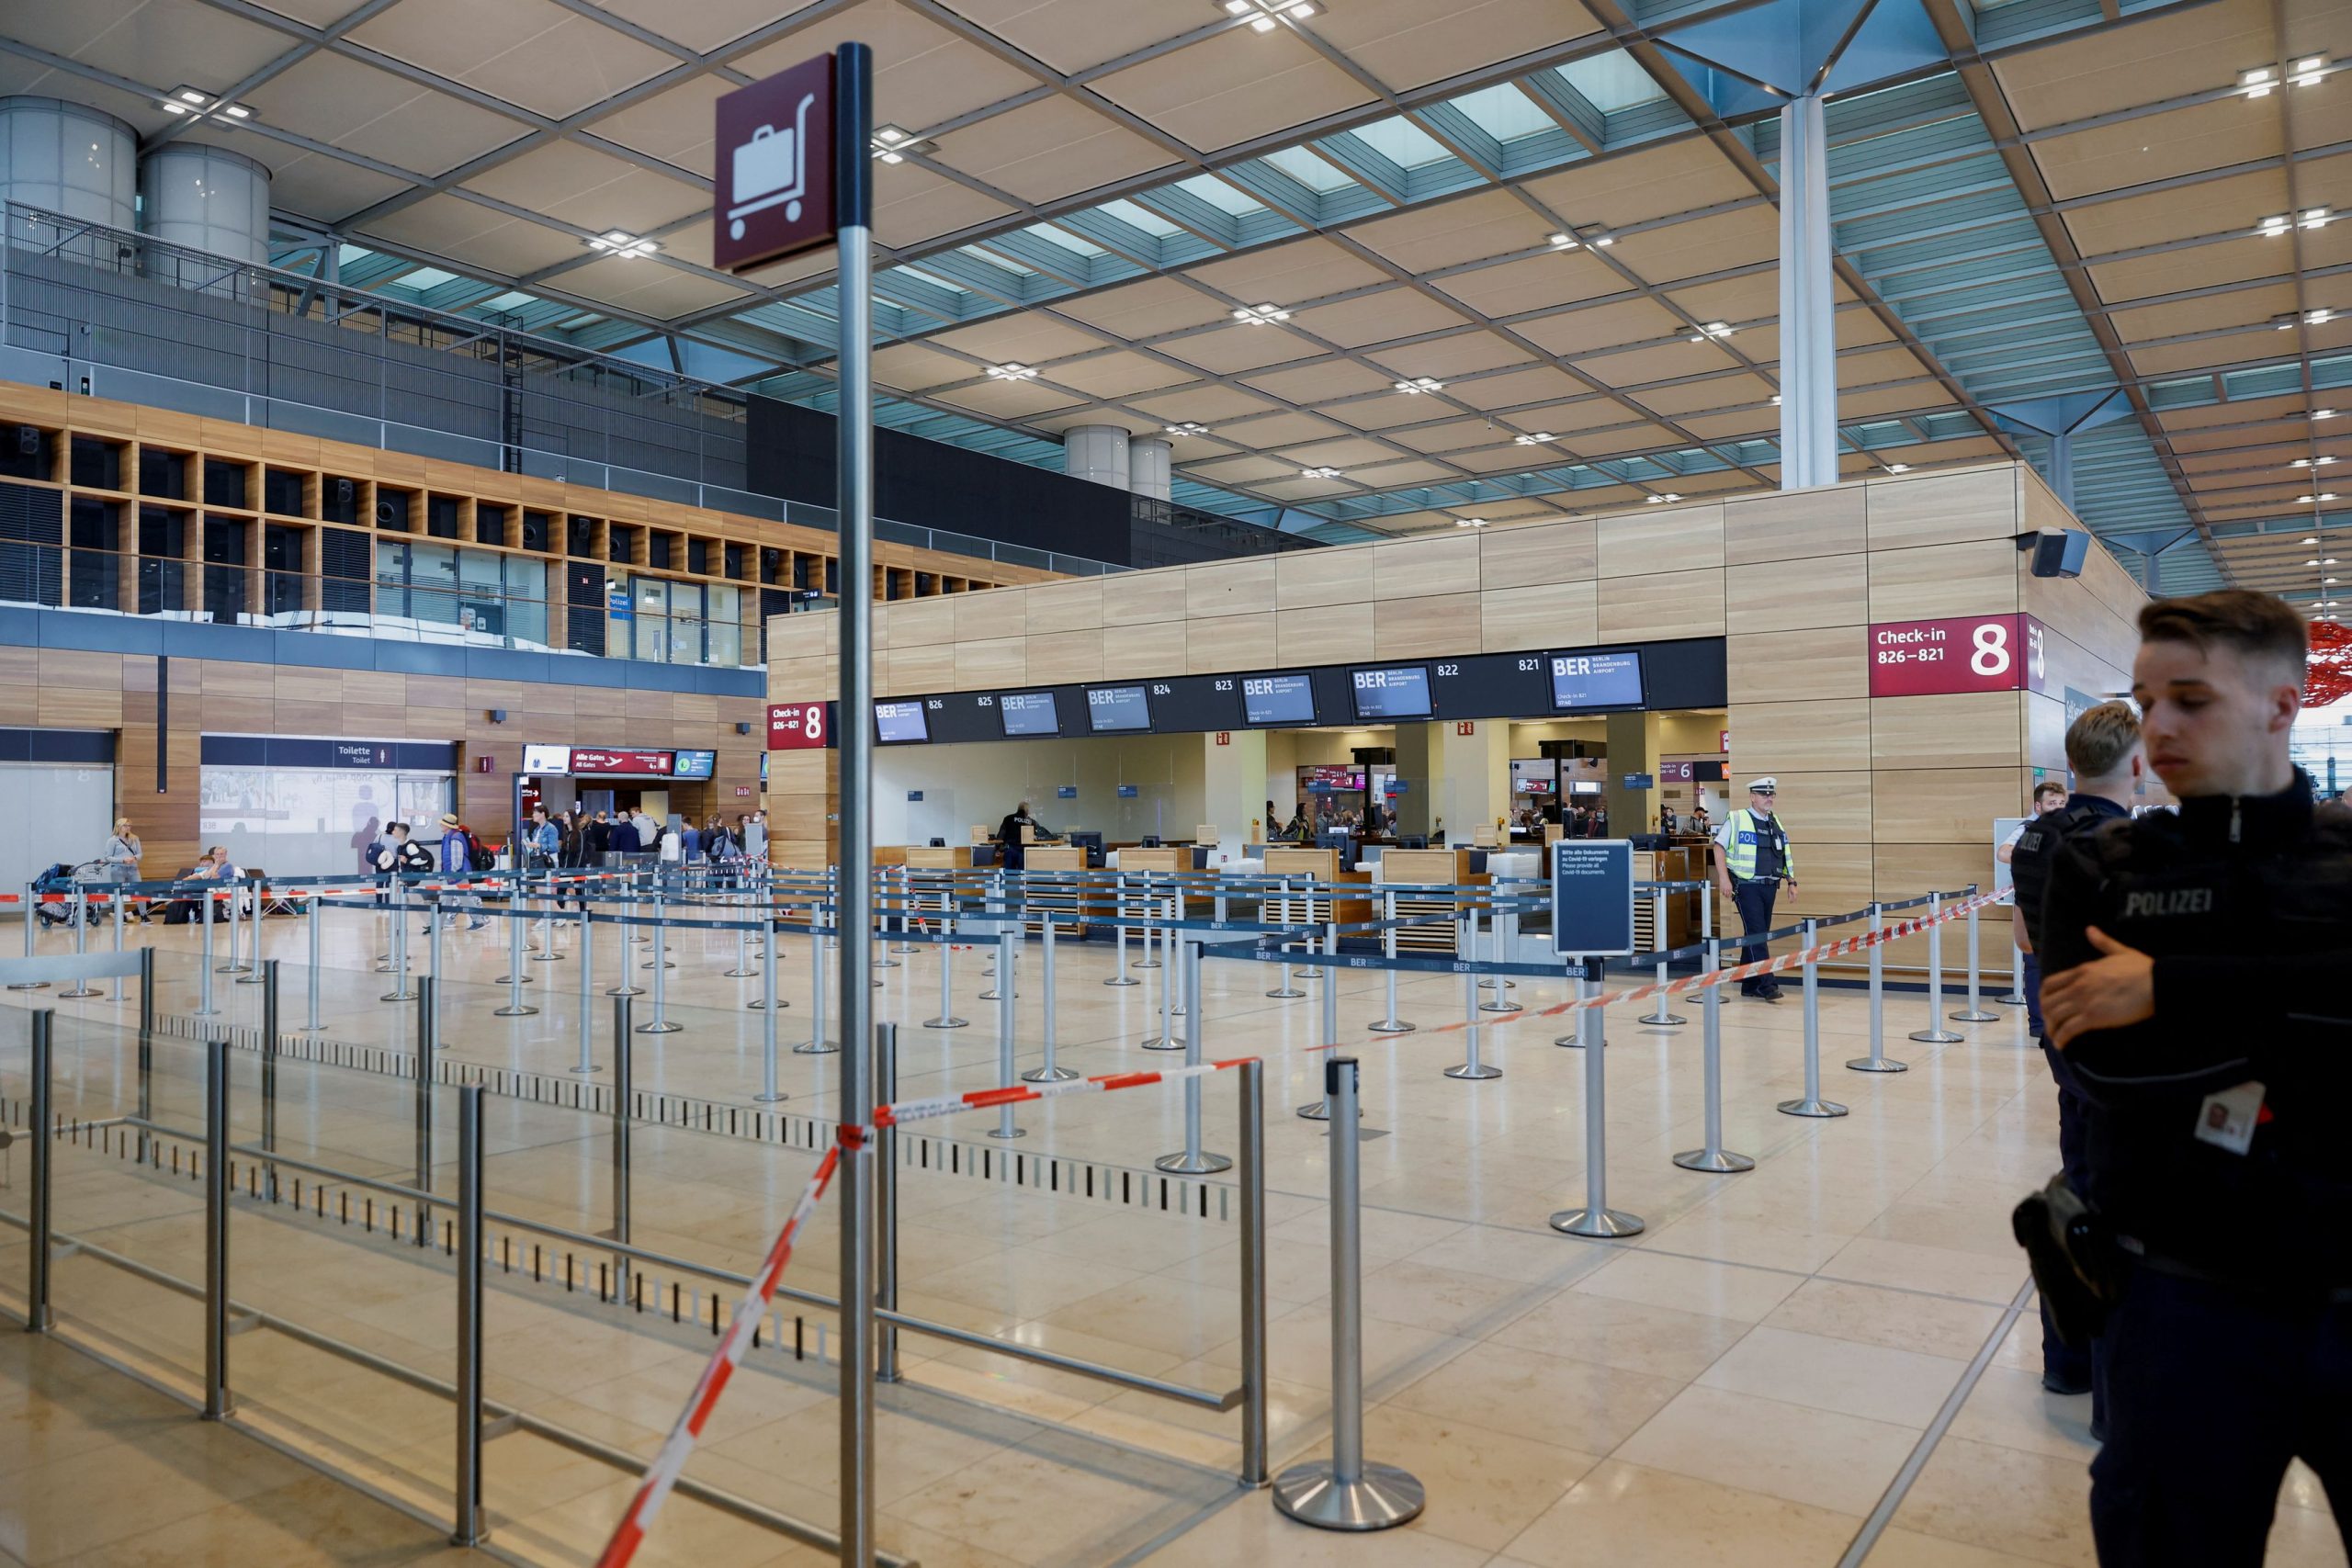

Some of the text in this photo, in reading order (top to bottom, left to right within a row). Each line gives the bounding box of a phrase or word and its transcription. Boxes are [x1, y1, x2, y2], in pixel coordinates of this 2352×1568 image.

[1877, 628, 1946, 645] Check-in
[1970, 624, 2010, 676] 8
[2037, 629, 2045, 679] 8
[1438, 665, 1459, 676] 822
[1519, 659, 1539, 671] 821
[1553, 658, 1590, 676] BER
[1215, 680, 1233, 691] 823
[1355, 672, 1386, 689] BER
[1153, 684, 1170, 695] 824
[1244, 679, 1273, 695] BER
[978, 697, 992, 706] 825
[1001, 697, 1025, 710] BER
[1088, 690, 1114, 705] BER
[928, 700, 943, 710] 826
[773, 709, 800, 718] Check-in
[875, 705, 897, 718] BER
[805, 706, 821, 739] 8
[339, 746, 371, 755] Toilette
[1680, 764, 1690, 778] 6
[2125, 888, 2212, 917] POLIZEI
[1256, 951, 1271, 960] BER
[1351, 958, 1366, 966] BER
[1453, 963, 1470, 971] BER
[1566, 967, 1585, 976] BER
